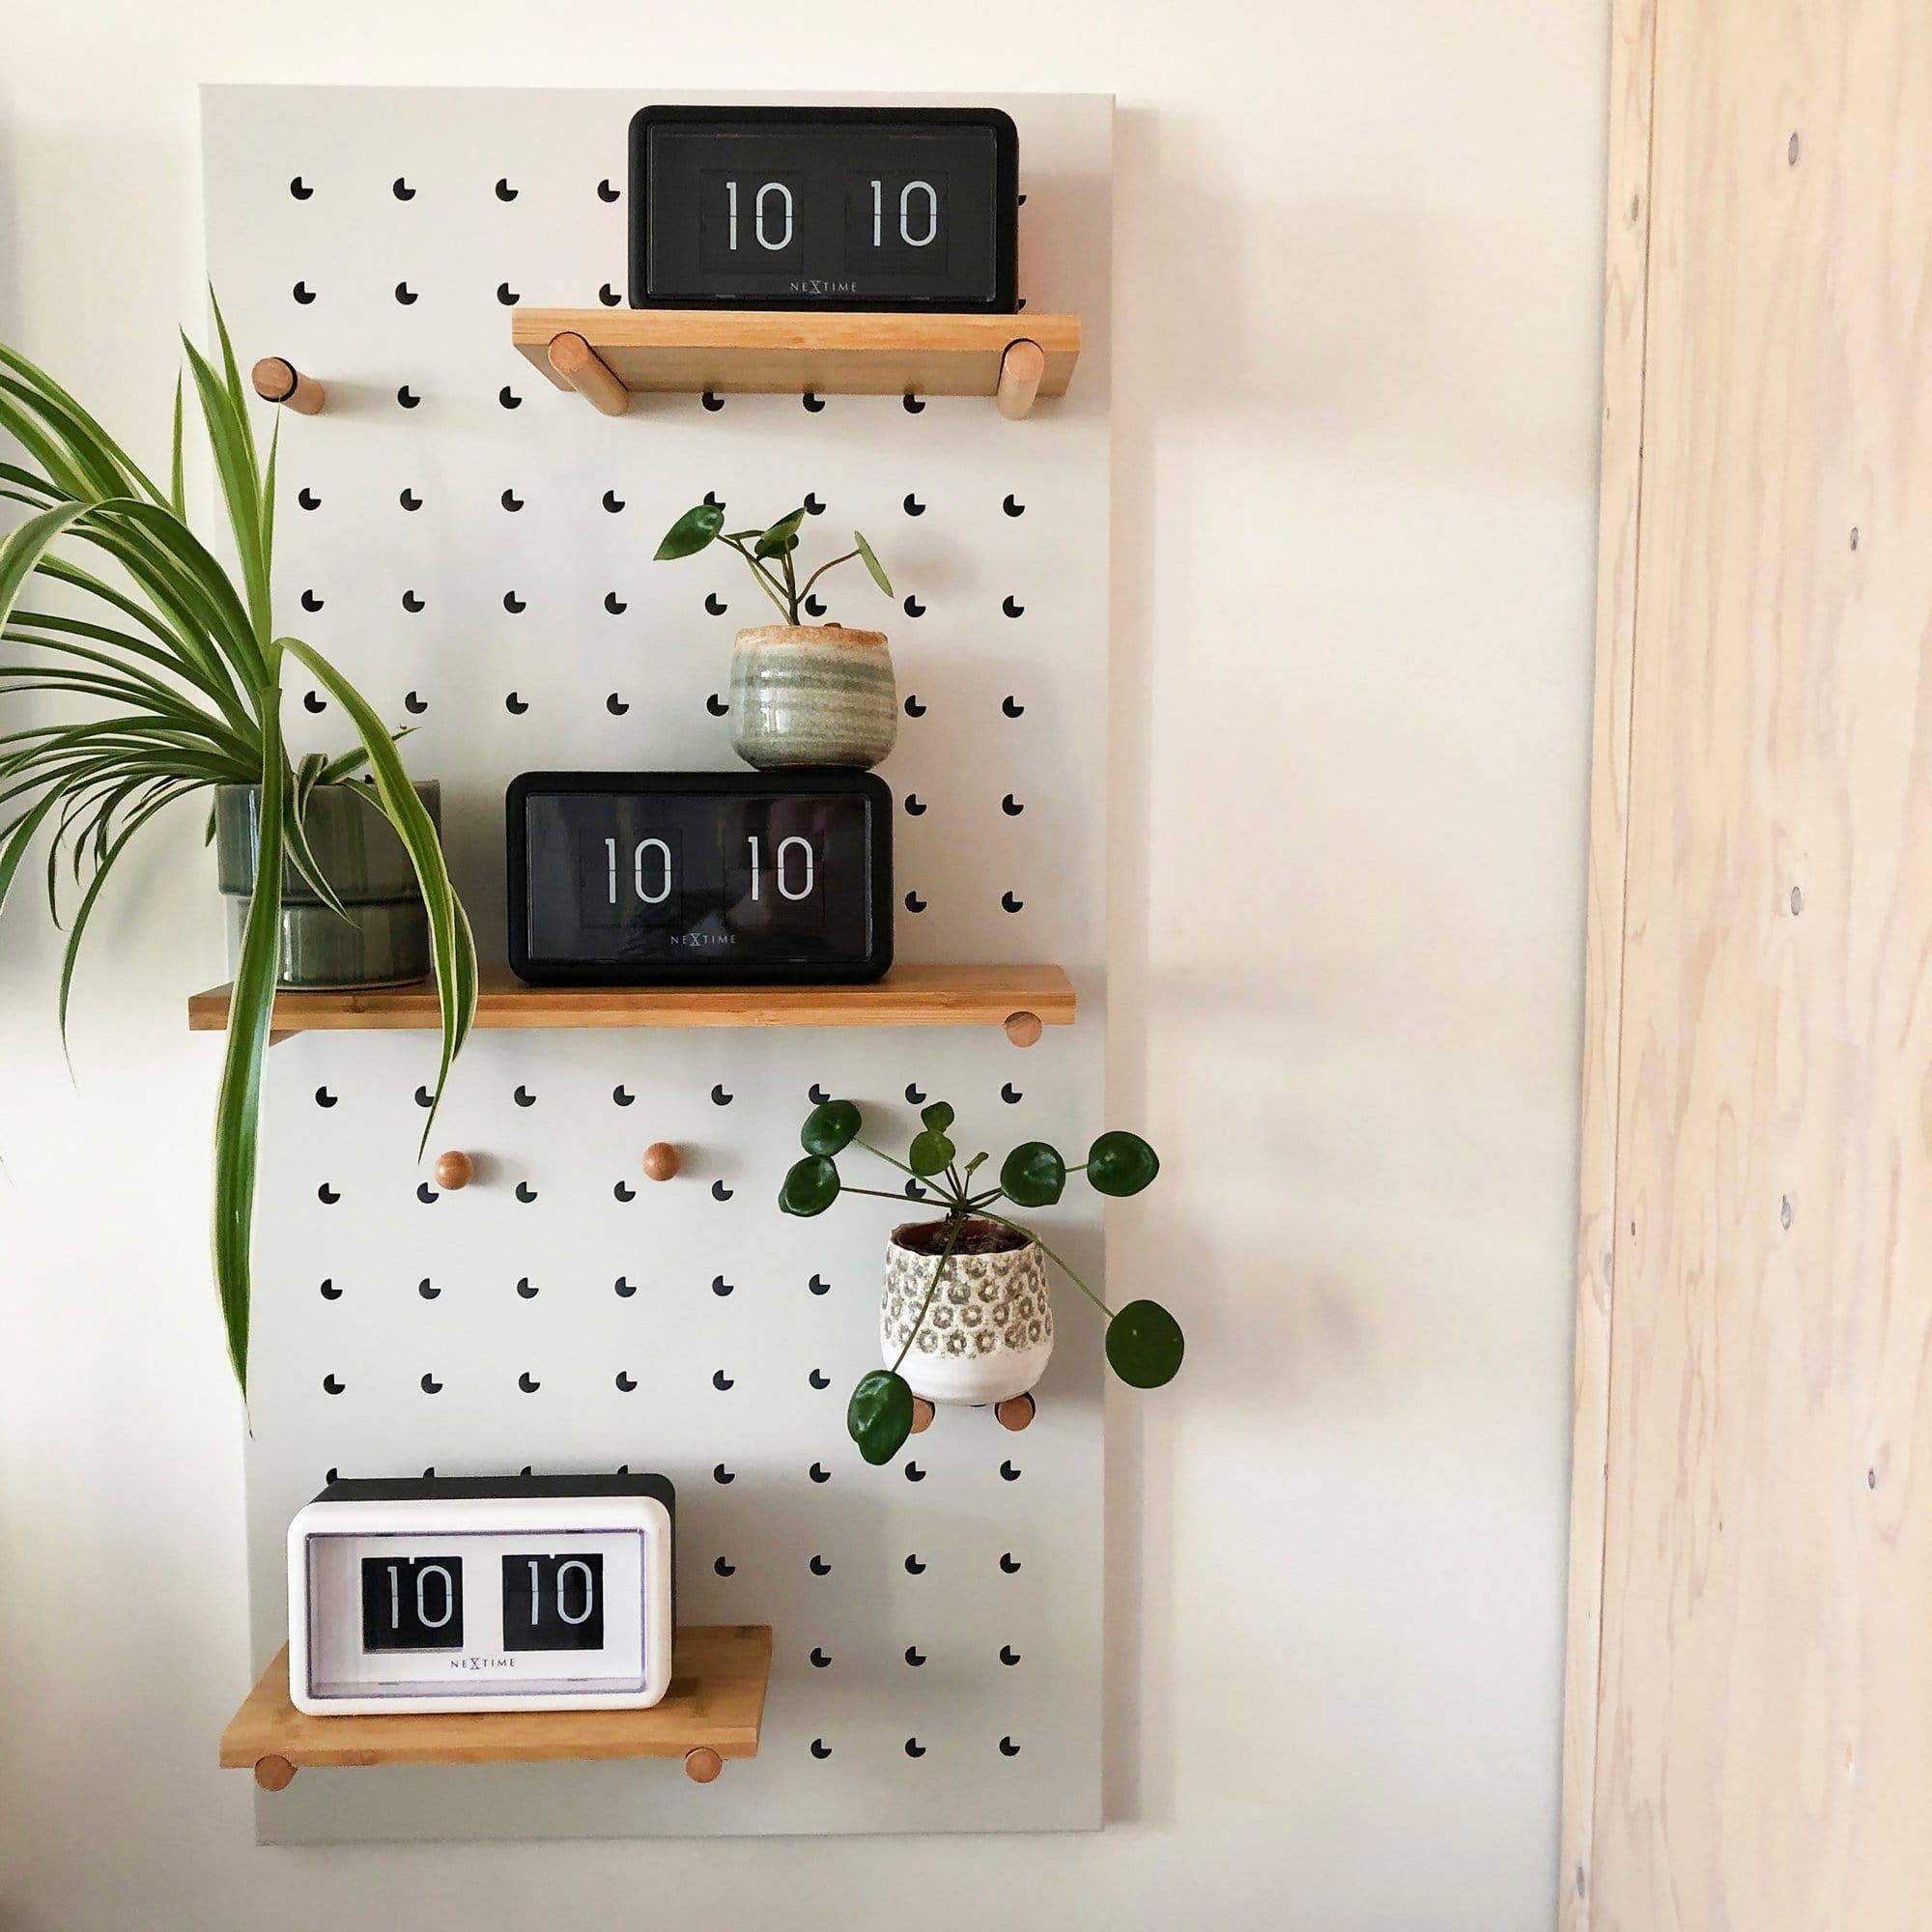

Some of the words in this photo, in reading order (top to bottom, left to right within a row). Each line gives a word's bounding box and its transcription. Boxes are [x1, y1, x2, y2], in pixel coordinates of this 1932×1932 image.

[726, 182, 793, 251] 10
[870, 180, 937, 247] 10
[790, 279, 858, 295] NEXTIME
[605, 838, 671, 904] 10
[748, 836, 813, 901] 10
[670, 932, 737, 947] NEXTIME
[387, 1565, 453, 1630] 10
[528, 1560, 593, 1626] 10
[450, 1657, 517, 1670] NEXTIME
